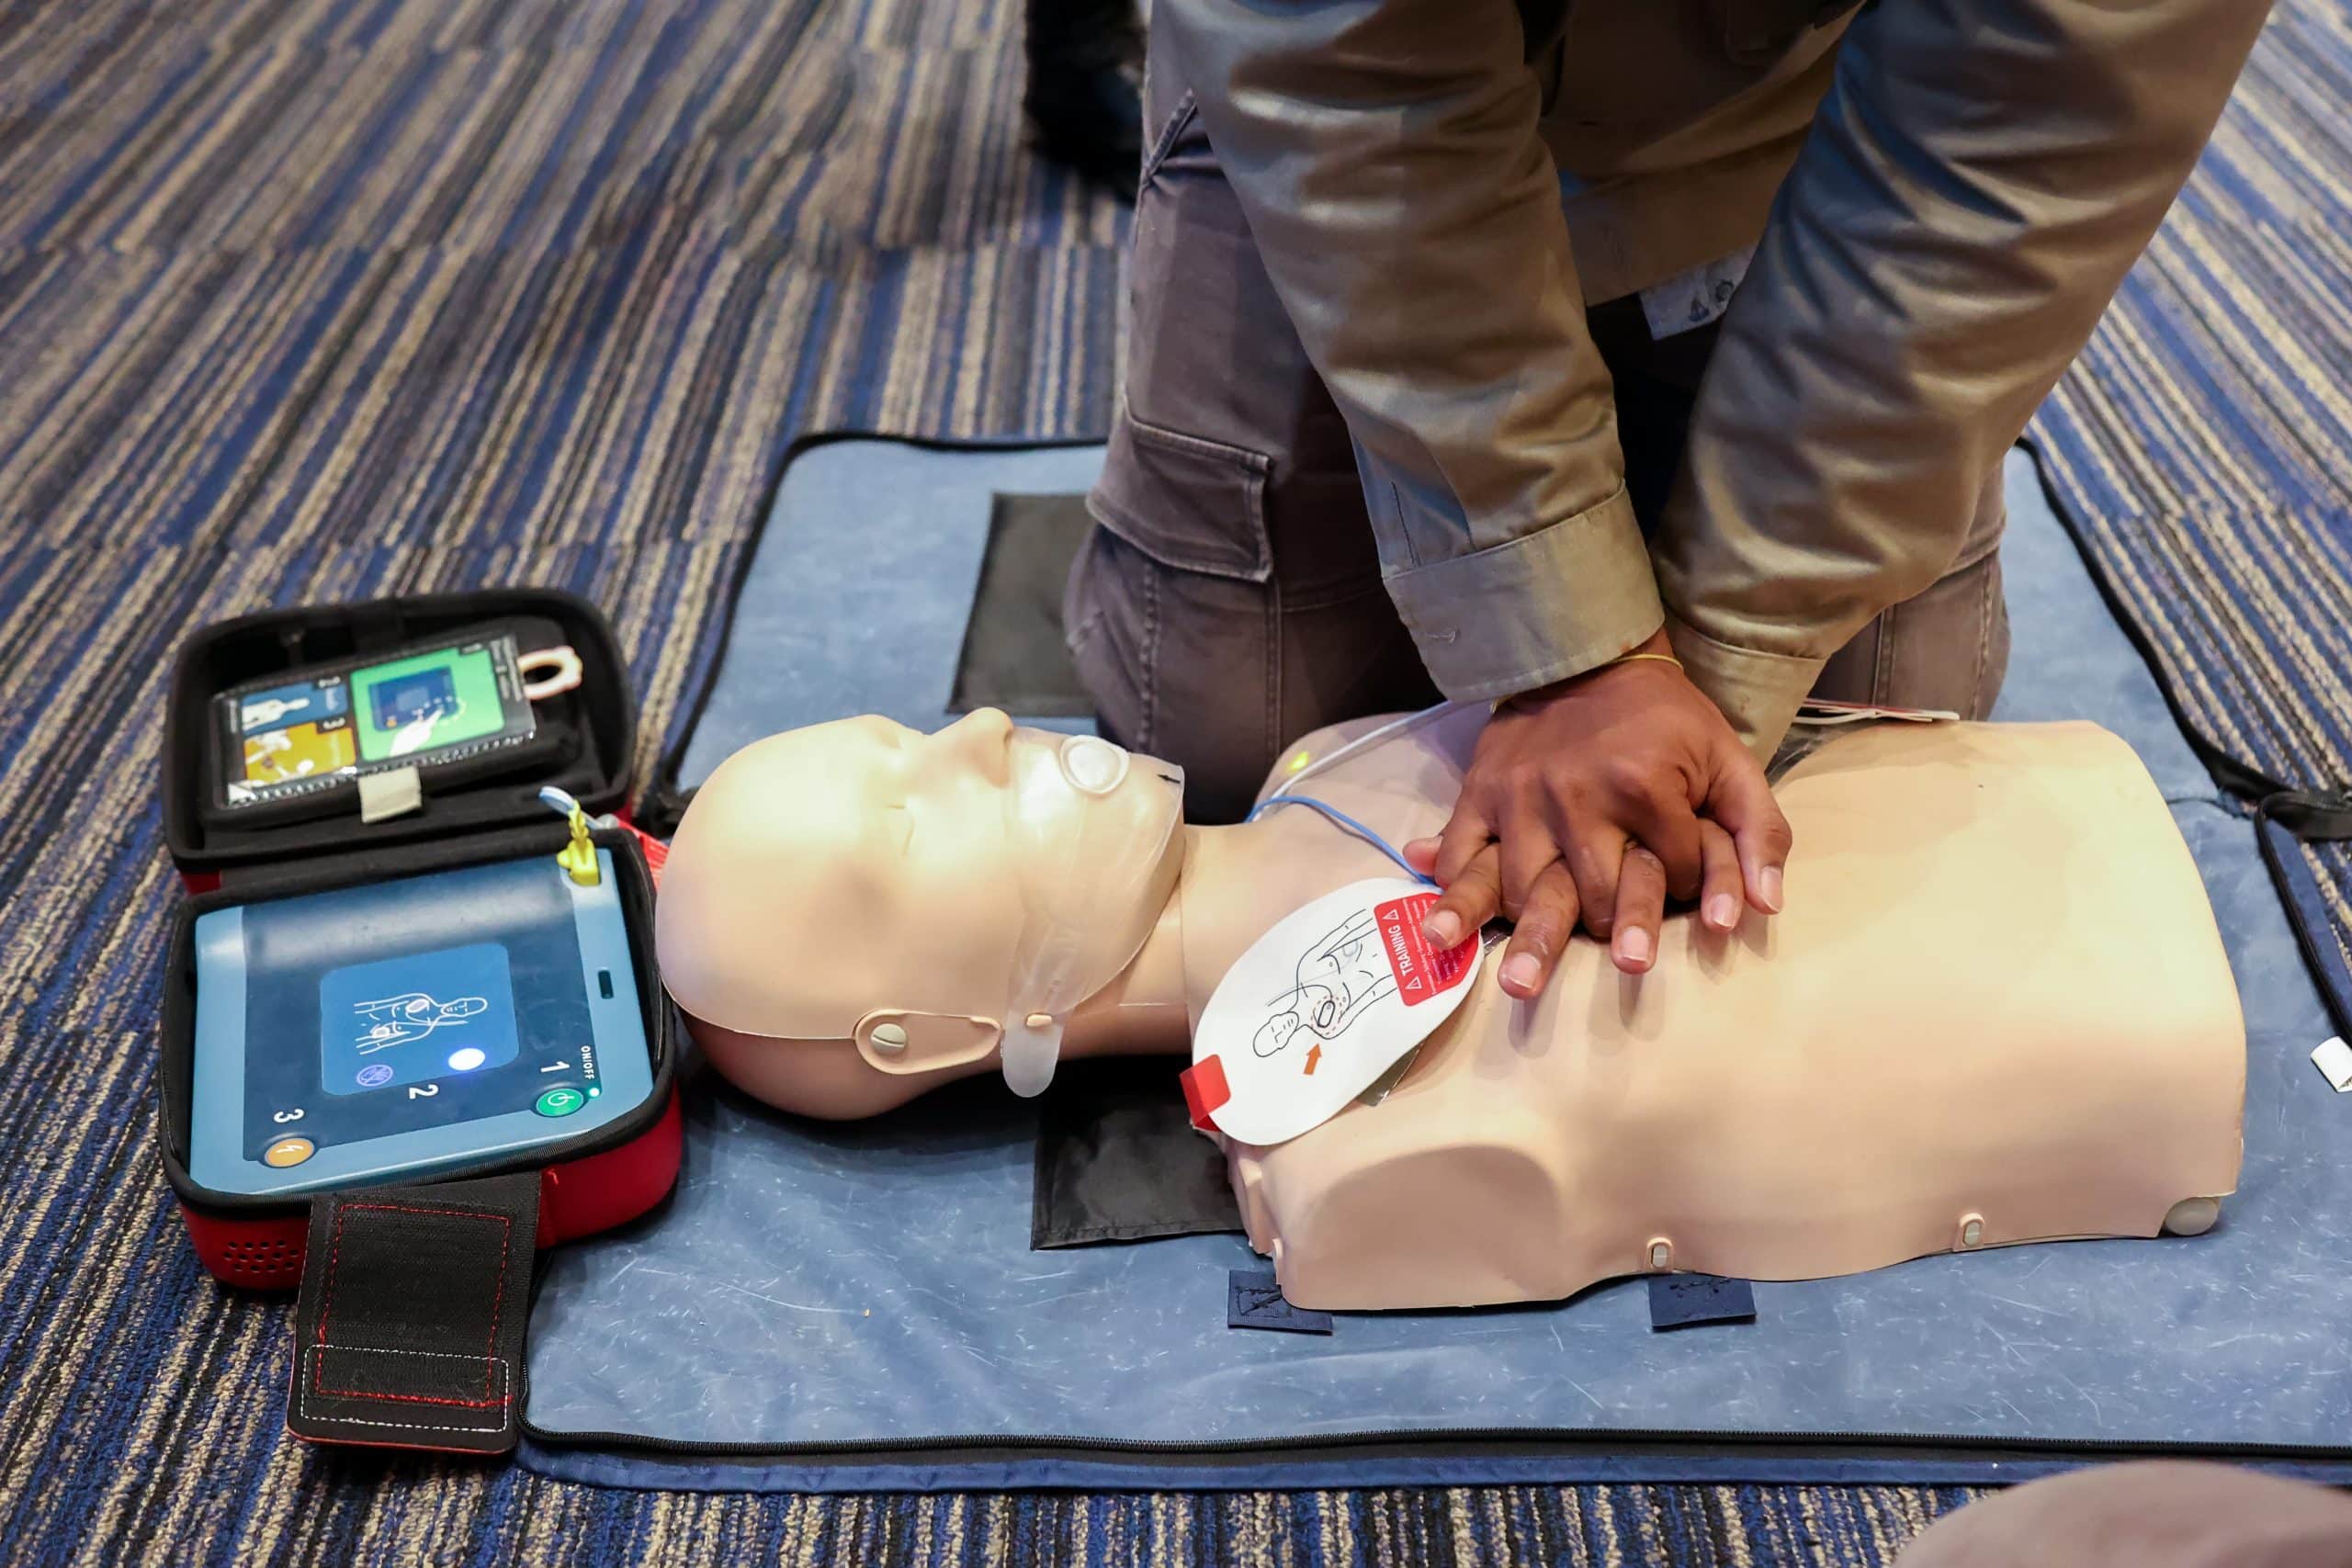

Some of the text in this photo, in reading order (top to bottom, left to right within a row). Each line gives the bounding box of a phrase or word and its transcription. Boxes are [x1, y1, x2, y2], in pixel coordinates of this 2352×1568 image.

[323, 717, 345, 729] 3
[1388, 924, 1414, 976] TRAINING
[540, 1061, 570, 1073] 1
[581, 1045, 595, 1079] ON/OFF
[408, 1084, 439, 1100] 2
[273, 1108, 305, 1123] 3
